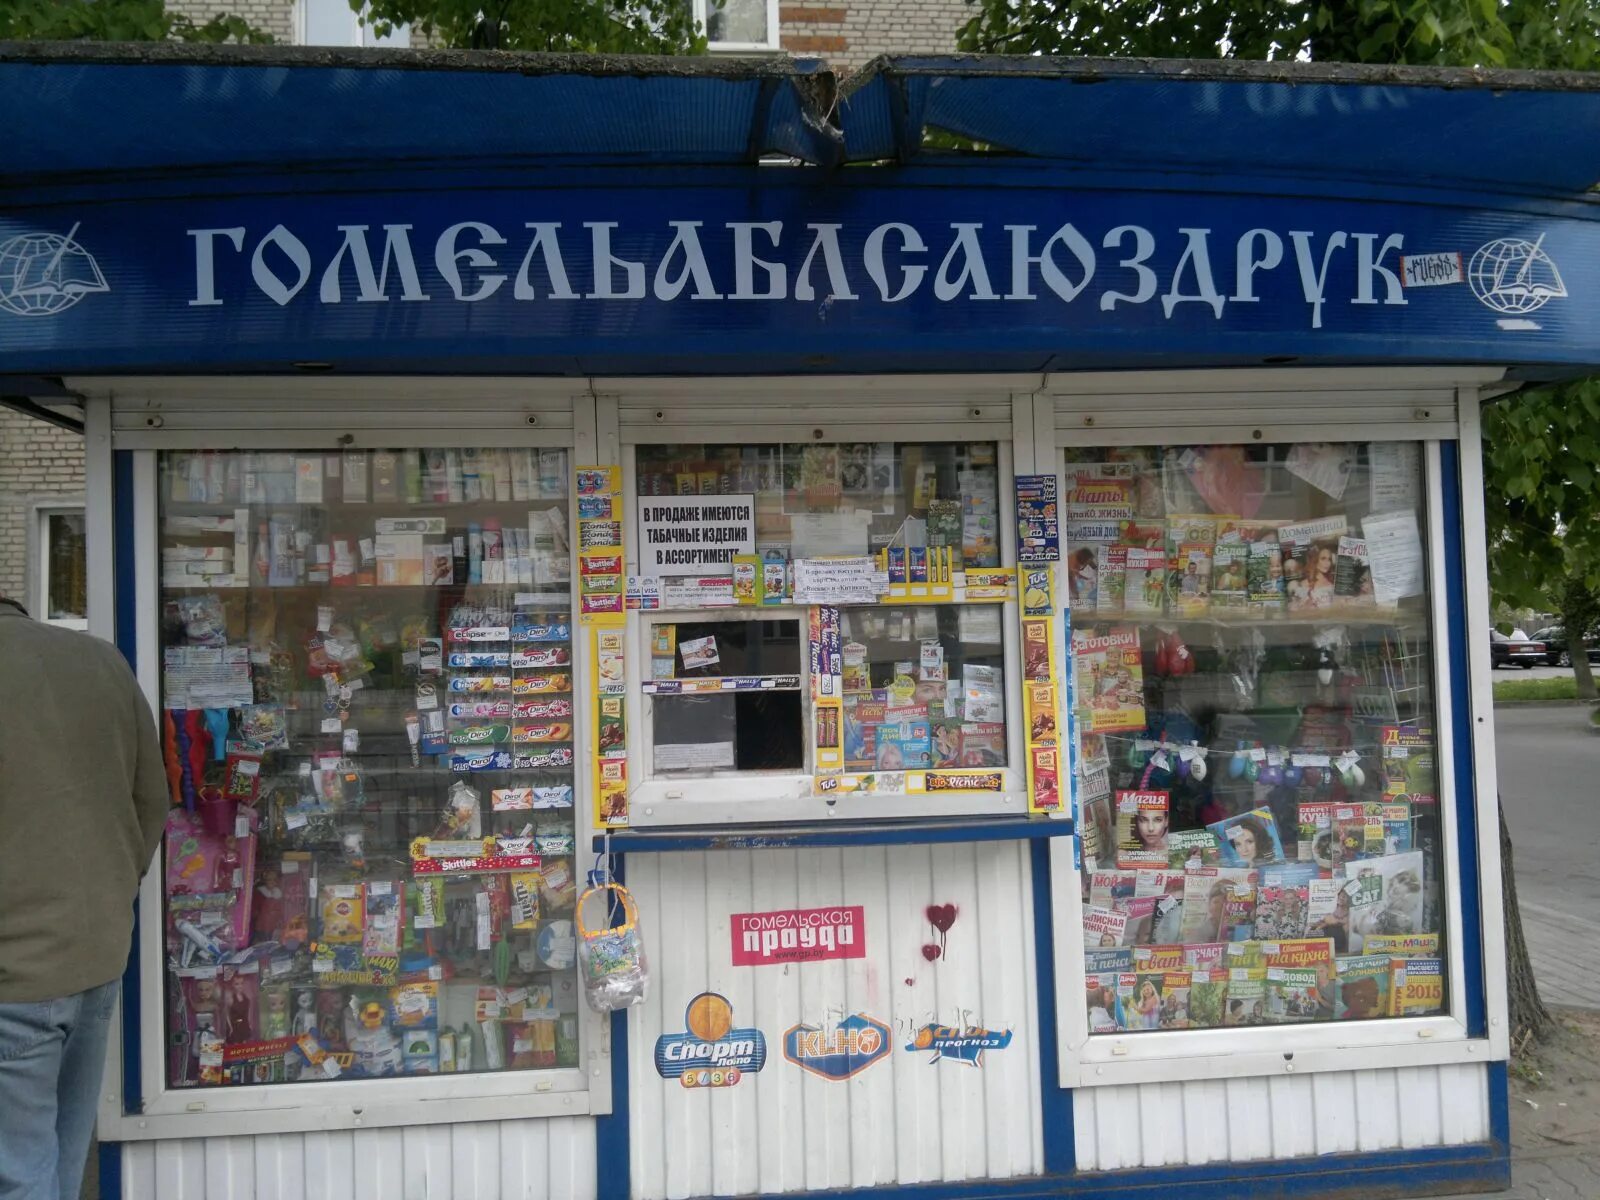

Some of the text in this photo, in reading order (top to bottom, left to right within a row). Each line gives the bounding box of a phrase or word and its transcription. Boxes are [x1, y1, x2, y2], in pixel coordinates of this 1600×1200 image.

[187, 220, 1409, 329] ГОМЕЛЬАБЛСАЮЗДРУК
[643, 506, 749, 523] В ПРОДАЖЕ ИМЕЮТСЯ
[647, 527, 747, 544] ТАБАЧНЫЕ ИЗДЕЛИЯ
[656, 550, 663, 564] В
[588, 558, 615, 569] Skittles
[588, 577, 615, 588] Skittles
[1028, 572, 1048, 584] TUC
[589, 598, 615, 608] Skittles
[455, 631, 486, 642] eclipse
[529, 654, 549, 662] Dirol
[811, 641, 820, 674] Picnic
[530, 680, 549, 688] Dirol
[698, 679, 717, 687] HALLS
[530, 705, 549, 713] Dirol
[470, 730, 493, 739] Dirol
[530, 728, 549, 736] Dirol
[470, 758, 492, 767] Dirol
[531, 754, 549, 763] Dirol
[820, 779, 837, 791] TUC
[930, 778, 945, 787] BIG
[949, 774, 980, 788] Picnic
[504, 792, 522, 800] Dirol
[543, 791, 561, 799] Dirol
[1122, 793, 1166, 805] Магия
[506, 841, 525, 849] Dirol
[546, 840, 564, 848] Dirol
[442, 859, 477, 870] Skittles
[1351, 889, 1380, 906] CAT
[1083, 914, 1124, 928] ПИСНАЯ
[1291, 950, 1329, 966] кухне
[1406, 984, 1441, 999] 2015
[935, 1038, 1000, 1048] ПРОГНОЗ
[664, 1038, 754, 1062] Спорт
